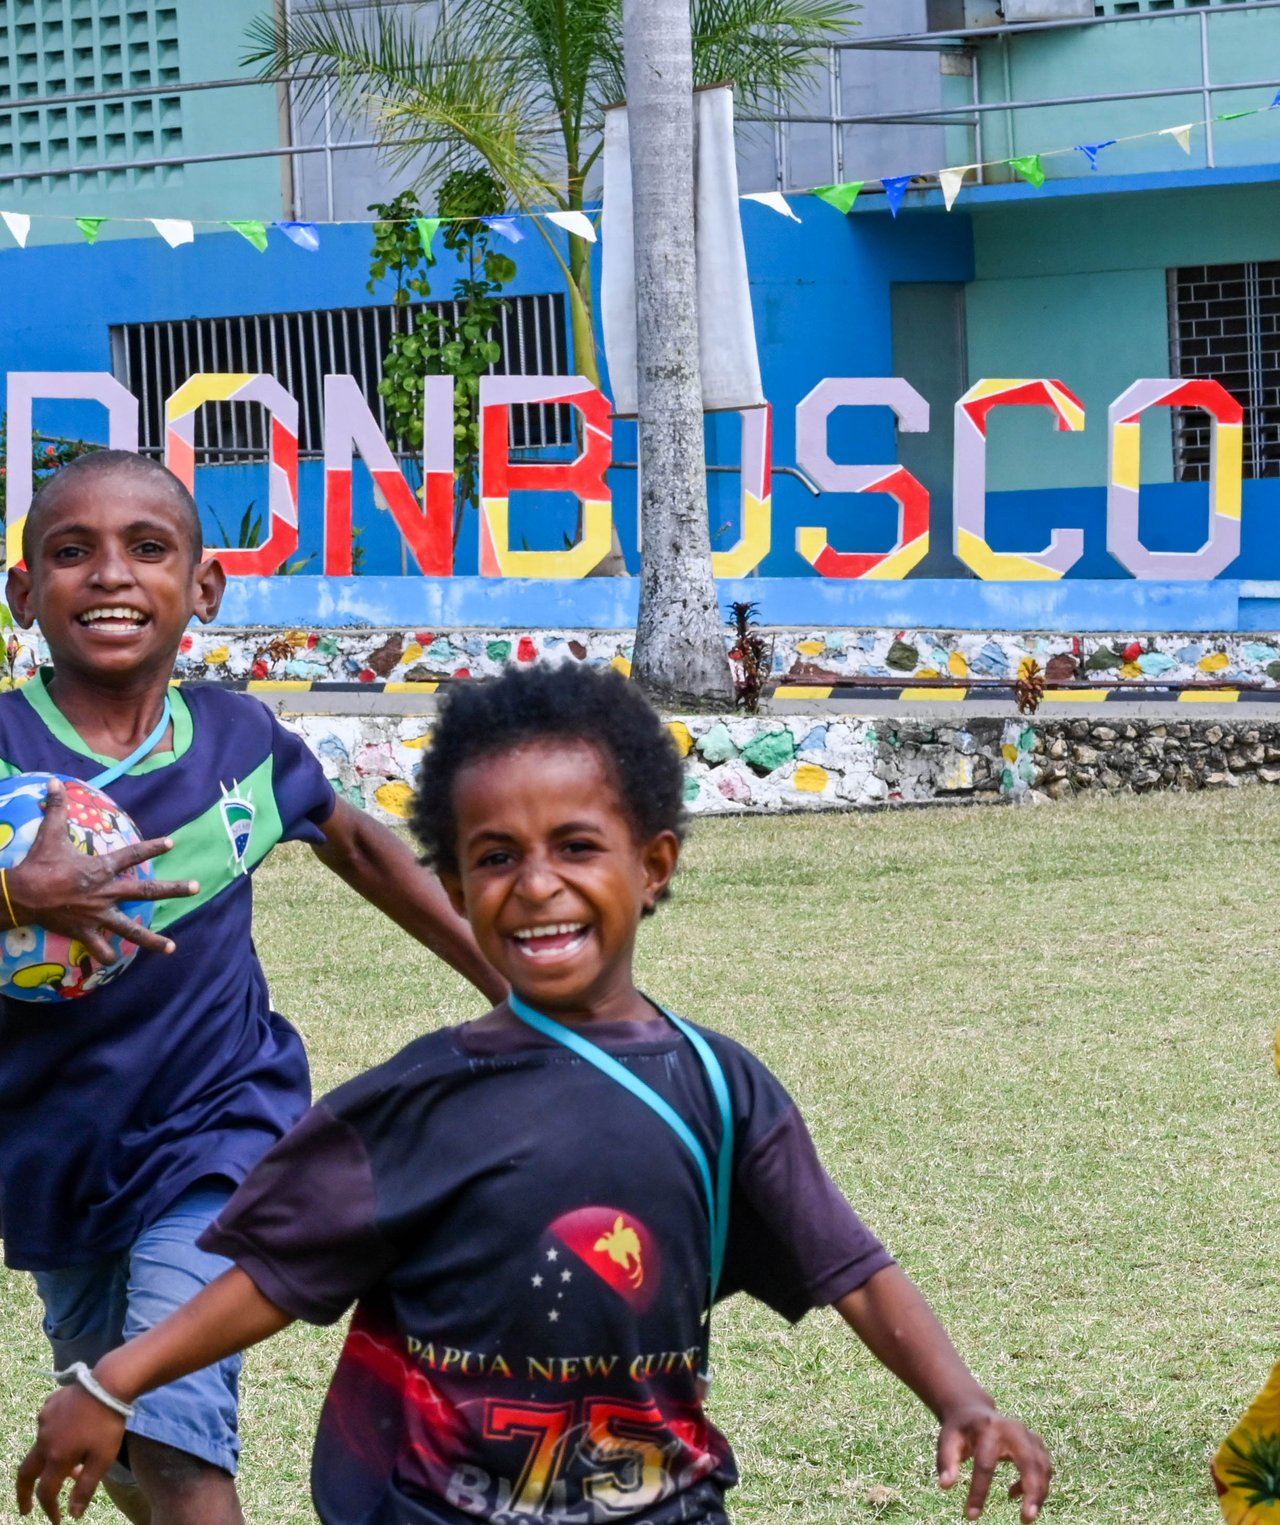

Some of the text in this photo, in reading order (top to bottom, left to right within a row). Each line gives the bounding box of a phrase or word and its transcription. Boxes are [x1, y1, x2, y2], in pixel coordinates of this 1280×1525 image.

[407, 1335, 701, 1384] PAPUA NEW GUIN
[483, 1396, 673, 1516] 75
